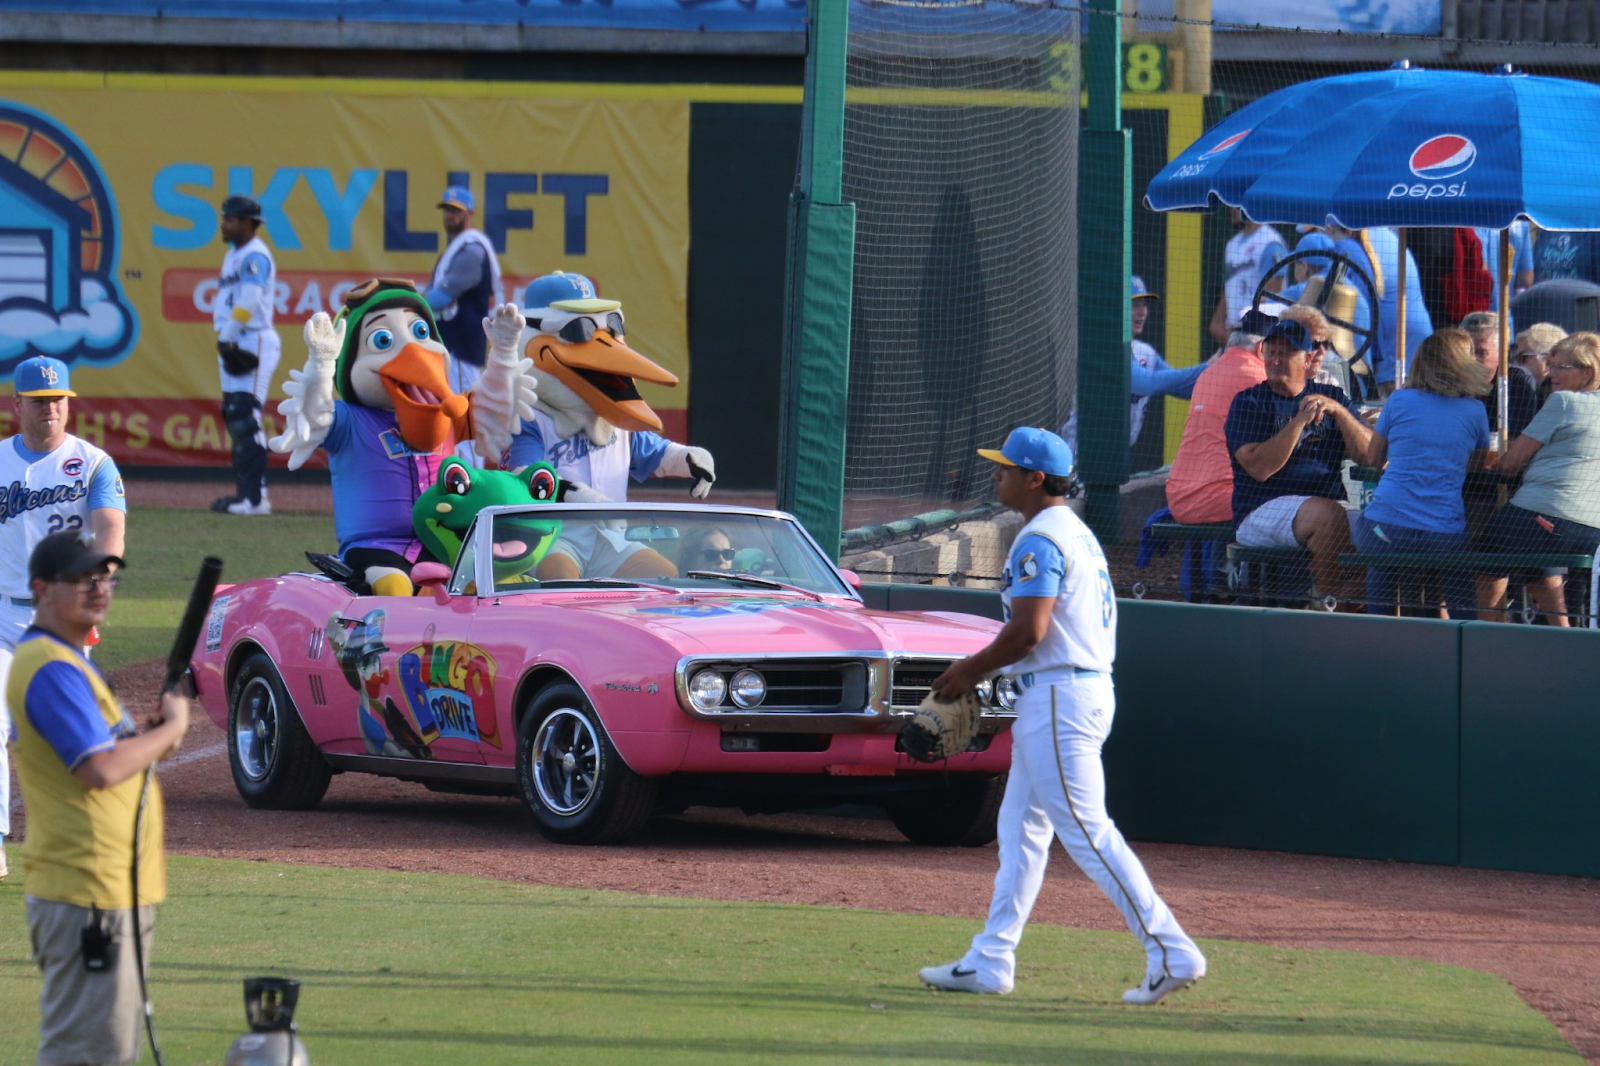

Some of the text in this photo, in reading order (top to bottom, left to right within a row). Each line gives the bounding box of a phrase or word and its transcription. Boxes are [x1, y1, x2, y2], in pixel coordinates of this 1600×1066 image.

[1386, 181, 1467, 200] pepsi
[40, 365, 59, 386] MB
[399, 642, 497, 738] BINGO
[430, 693, 477, 737] DRIVE
